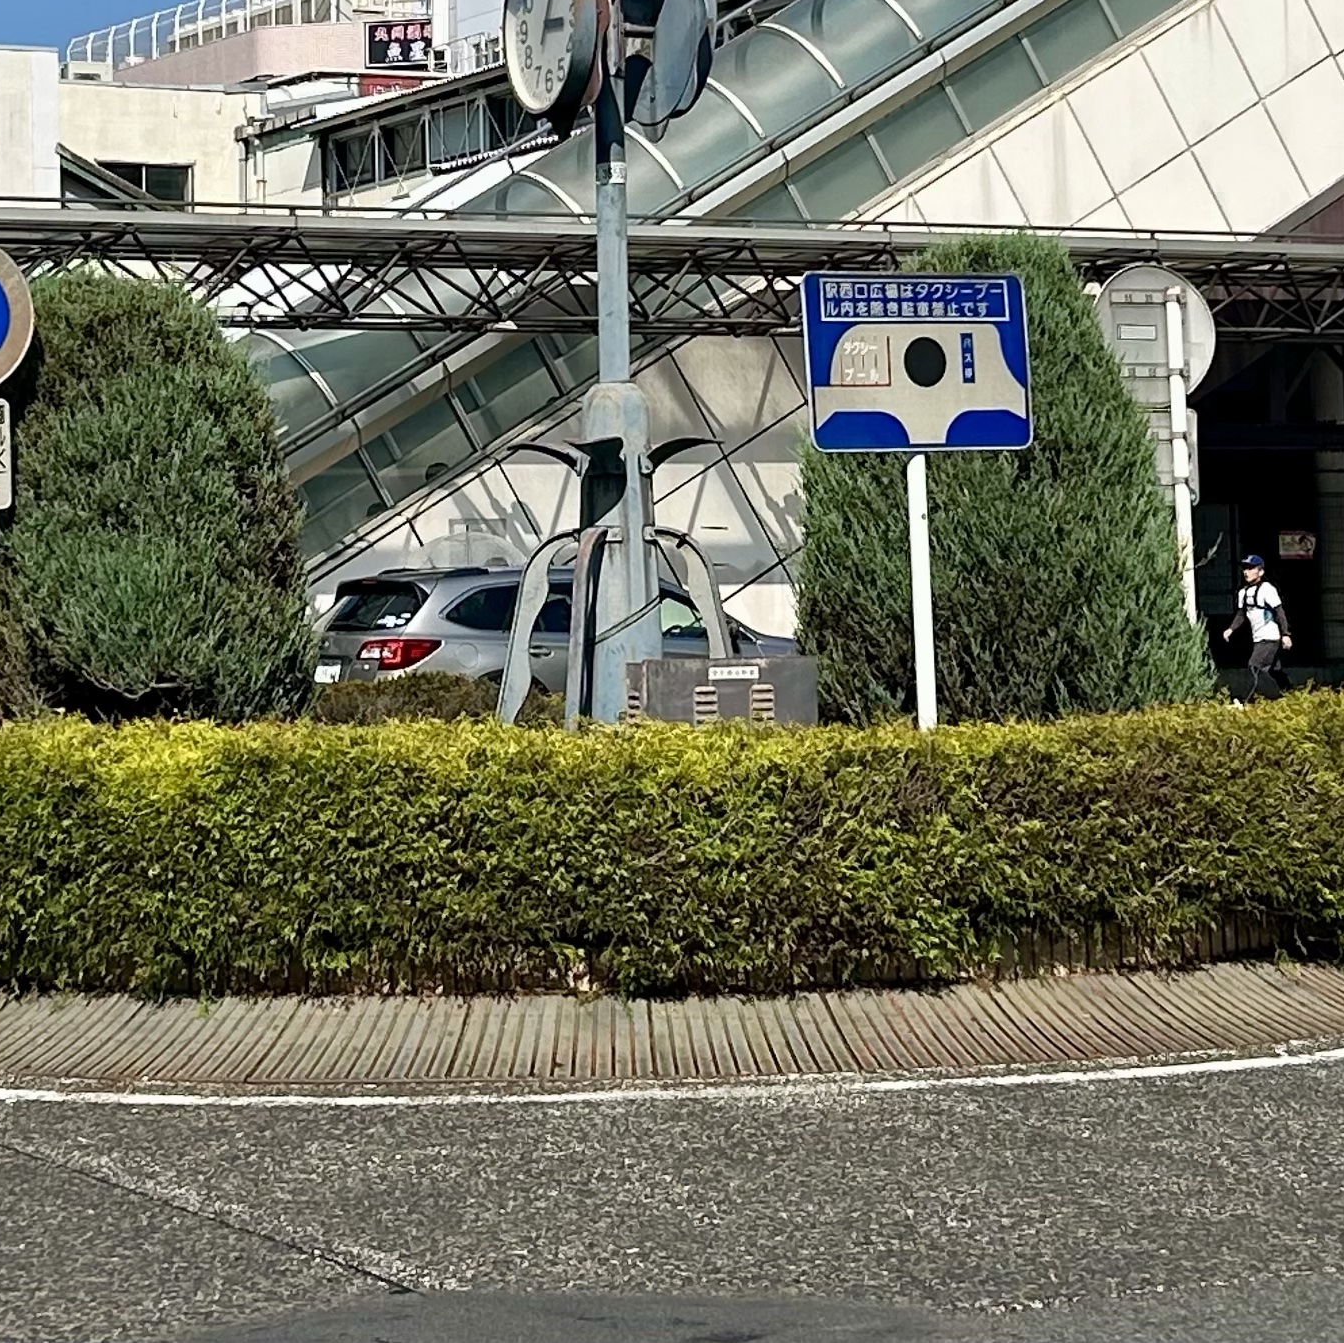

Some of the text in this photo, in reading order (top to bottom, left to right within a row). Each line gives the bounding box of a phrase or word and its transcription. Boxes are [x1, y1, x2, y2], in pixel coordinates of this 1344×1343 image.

[520, 19, 528, 45] 9
[524, 44, 533, 70] 8
[557, 57, 566, 82] 5
[534, 65, 542, 89] 7
[545, 68, 554, 94] 6
